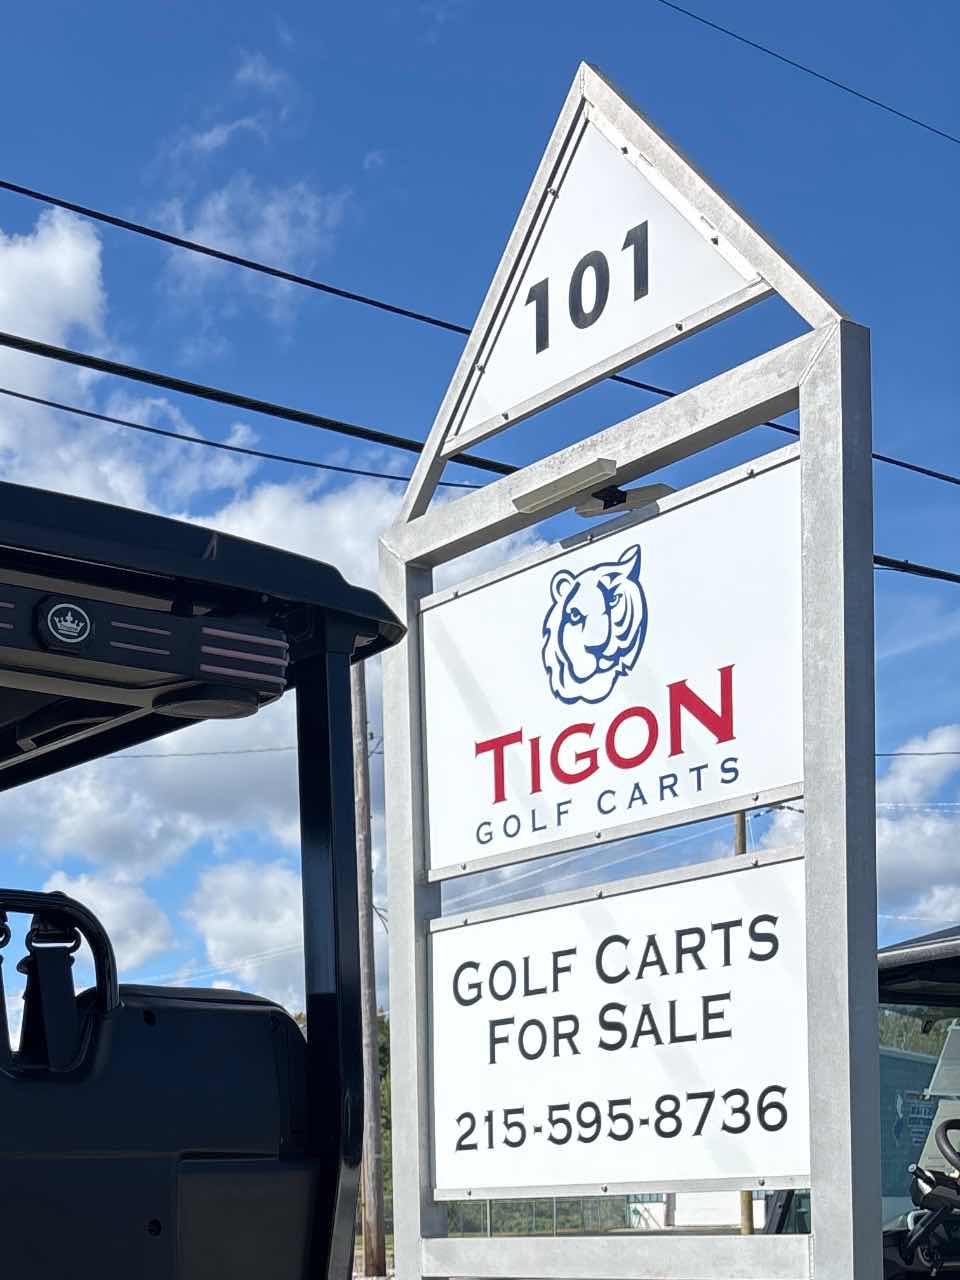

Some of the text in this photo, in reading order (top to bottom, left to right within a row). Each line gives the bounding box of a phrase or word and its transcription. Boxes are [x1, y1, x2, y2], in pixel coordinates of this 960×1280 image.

[524, 219, 649, 355] 101
[474, 663, 738, 805] TIGON
[475, 757, 740, 846] GOLF CARTS
[452, 913, 780, 1007] GOLF CARTS
[488, 990, 733, 1065] FOR SALE
[454, 1084, 788, 1152] 215-595-8736
